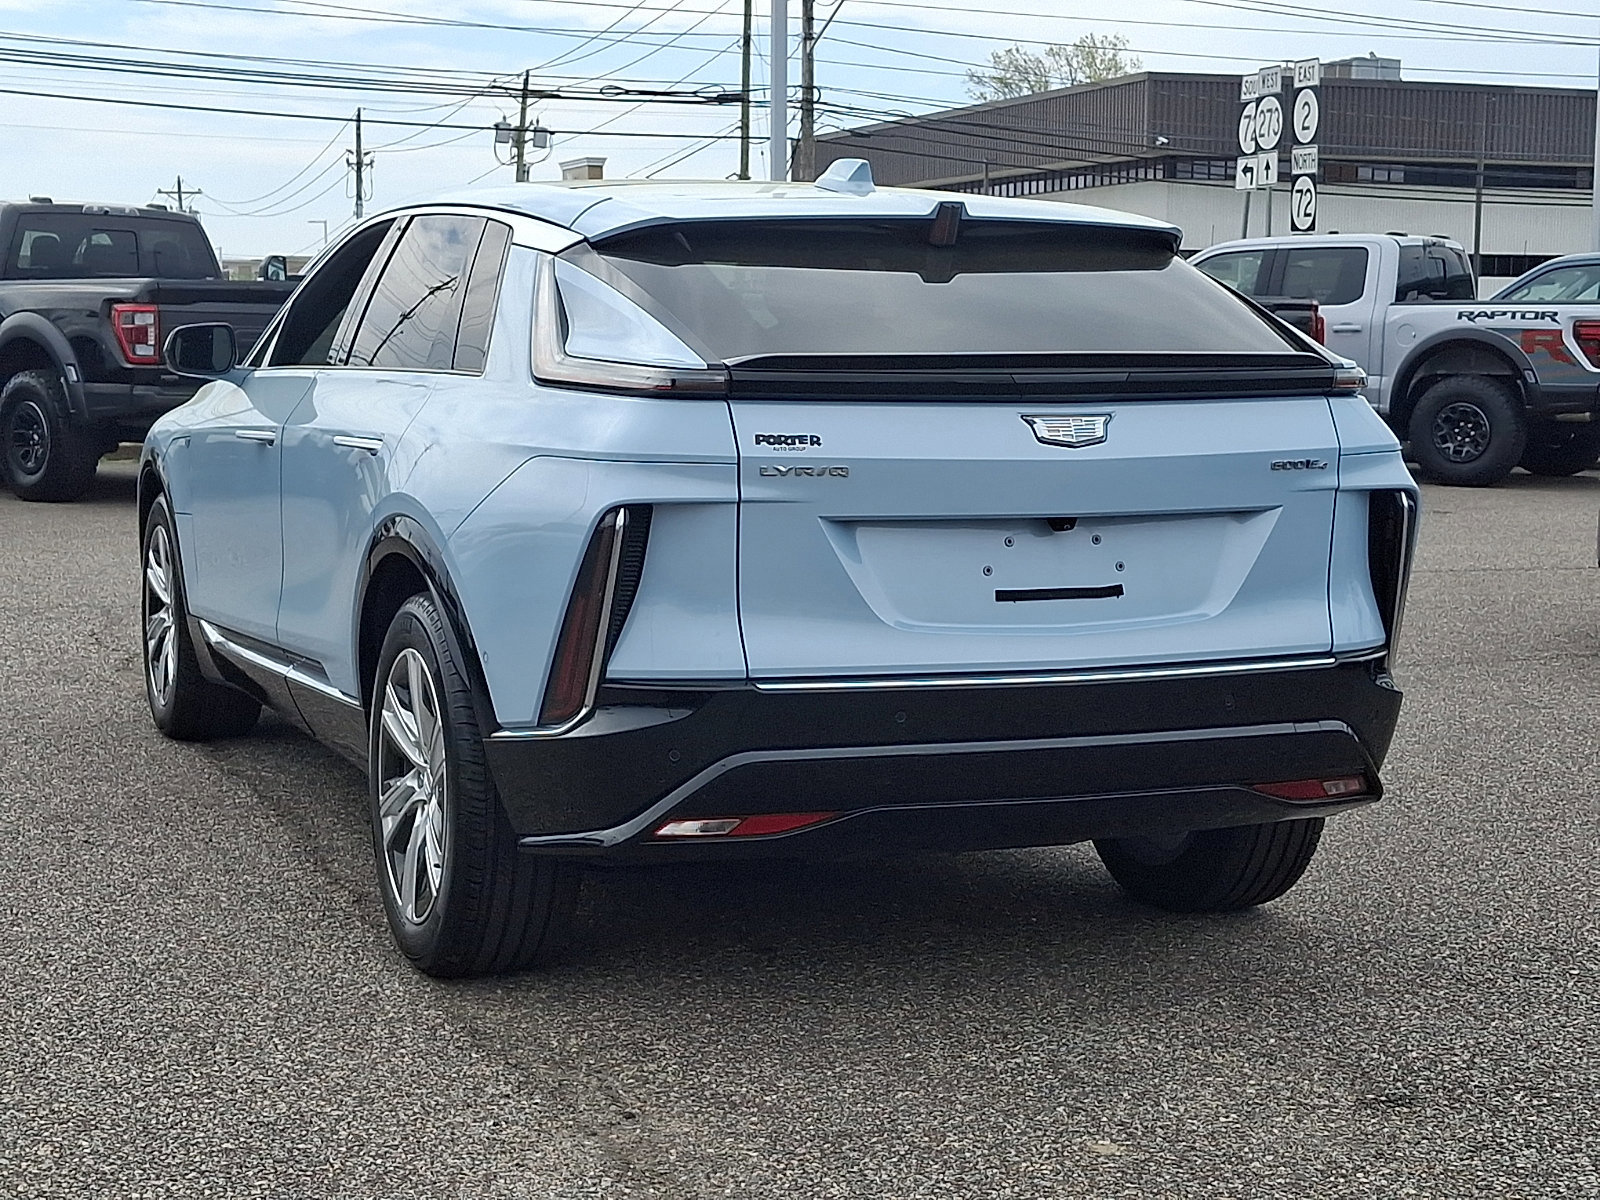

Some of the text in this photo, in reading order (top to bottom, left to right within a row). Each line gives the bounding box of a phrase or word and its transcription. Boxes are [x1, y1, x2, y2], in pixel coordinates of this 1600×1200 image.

[1261, 72, 1279, 90] WEST
[1298, 65, 1315, 83] EAST
[1243, 78, 1257, 96] SOU
[1258, 107, 1280, 138] 273
[1301, 101, 1311, 131] 2
[1293, 154, 1316, 171] NORTH
[1295, 188, 1313, 218] 72
[1457, 310, 1561, 325] RAPTOR
[754, 433, 823, 447] PORTER
